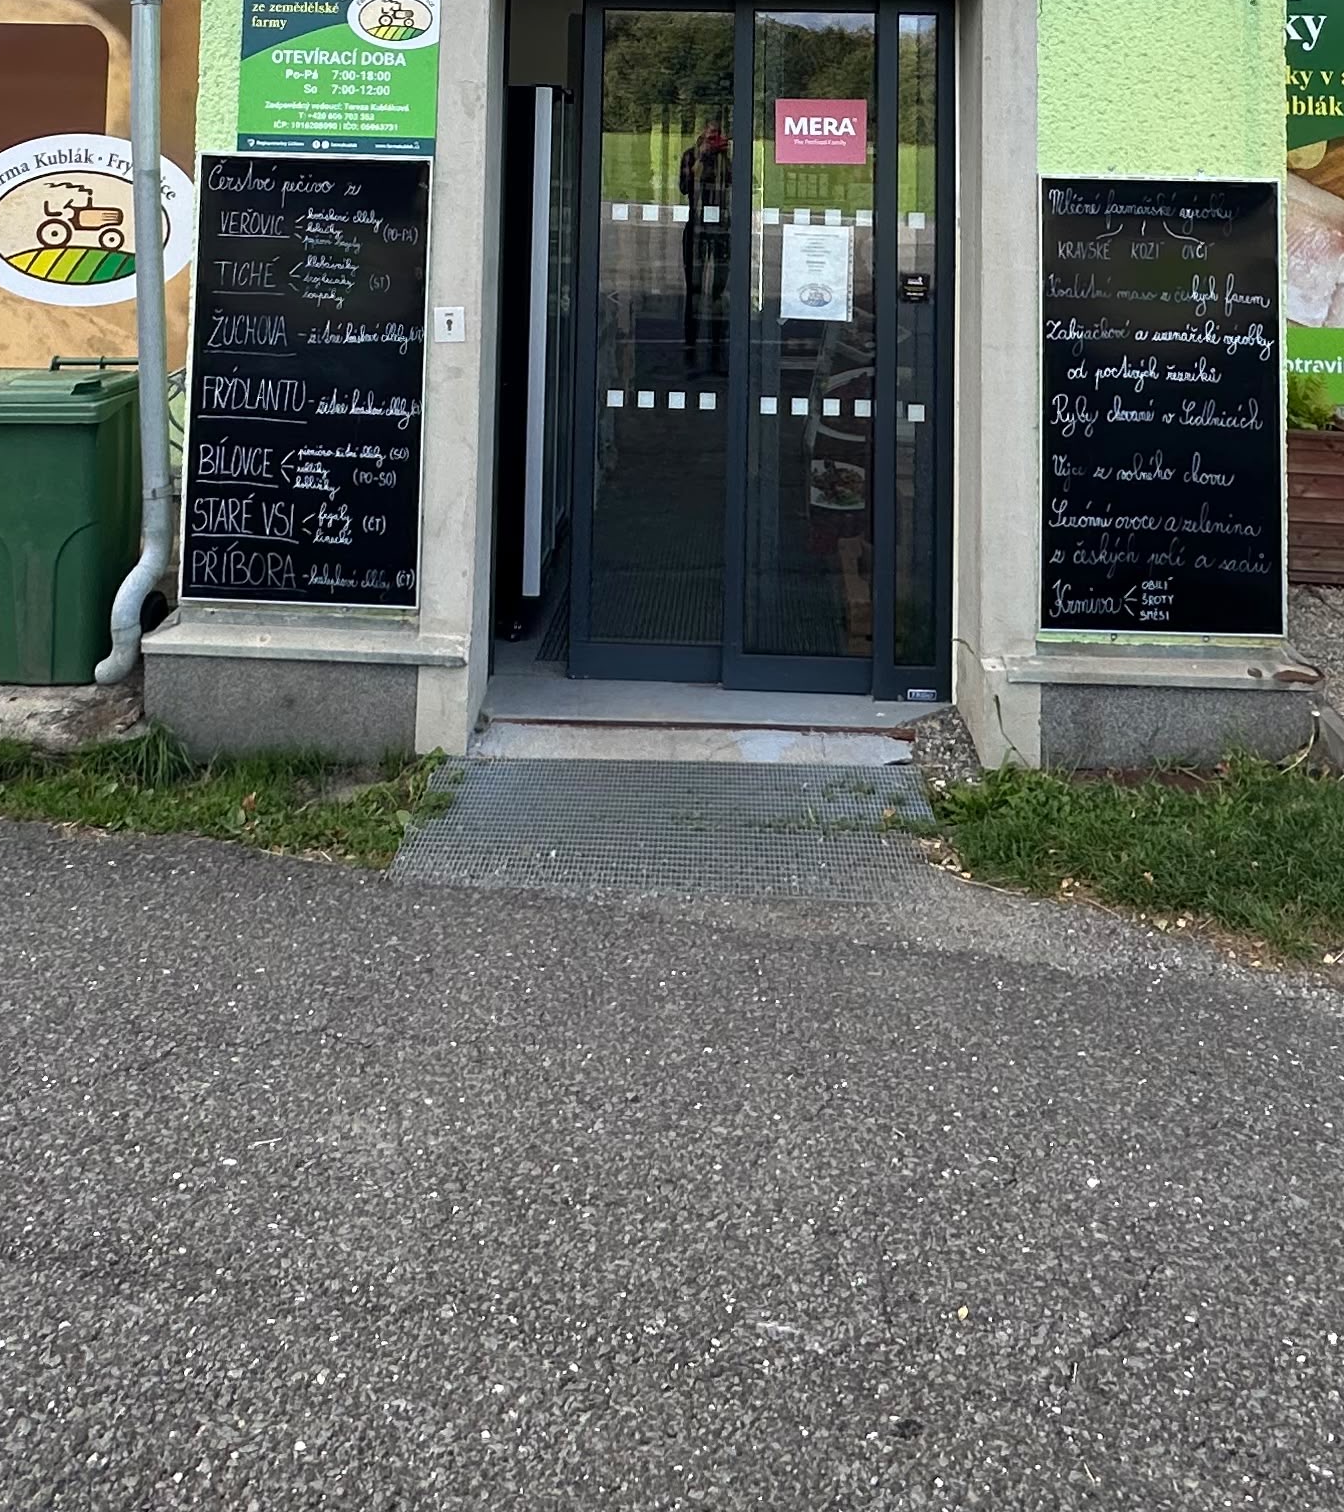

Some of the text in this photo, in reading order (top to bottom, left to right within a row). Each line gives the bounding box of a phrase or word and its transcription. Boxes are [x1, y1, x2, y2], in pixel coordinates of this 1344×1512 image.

[252, 1, 339, 14] ze zemědělské
[251, 16, 287, 30] farmy
[272, 47, 406, 66] OTEVÍRACÍ DOBA
[332, 69, 391, 81] 7:00-18:00
[1320, 70, 1334, 86] v
[303, 84, 391, 95] So 7:00-12:00
[784, 117, 856, 136] MERA
[33, 148, 94, 169] Kublák
[208, 159, 361, 207] Čerstvé pečivo z
[1049, 188, 1102, 216] Mléčné
[220, 208, 286, 236] VEŘOVIC
[1058, 239, 1113, 260] KRAVSKÉ
[1131, 241, 1165, 260] KOZÍ
[213, 256, 281, 288] TICHÉ
[369, 273, 391, 292] (ST)
[1224, 273, 1271, 317] farem
[207, 309, 288, 347] ŽUCHOVA
[1135, 329, 1149, 342] a
[1067, 359, 1088, 380] od
[1094, 355, 1159, 392] poctivých
[202, 366, 306, 412] FRÝDLANTU
[1050, 393, 1099, 437] Ryby
[1161, 412, 1176, 425] v
[1179, 398, 1263, 431] Sedlnicích
[197, 436, 274, 478] BÍLOVCE
[389, 447, 410, 461] (SO)
[1093, 467, 1112, 480] z
[1117, 449, 1176, 481] volného
[1183, 451, 1235, 487] chovu
[352, 468, 397, 488] (PO-SO)
[192, 493, 256, 535] STARÉ
[262, 502, 295, 537] VSI
[362, 515, 387, 535] (ČT)
[1048, 498, 1262, 537] Sezónní ovoce a zelenina
[192, 541, 297, 589] PŘÍBORA
[396, 568, 416, 590] (ČT)
[1049, 532, 1272, 579] z českých polí a sadů
[1048, 579, 1122, 618] Krmiva
